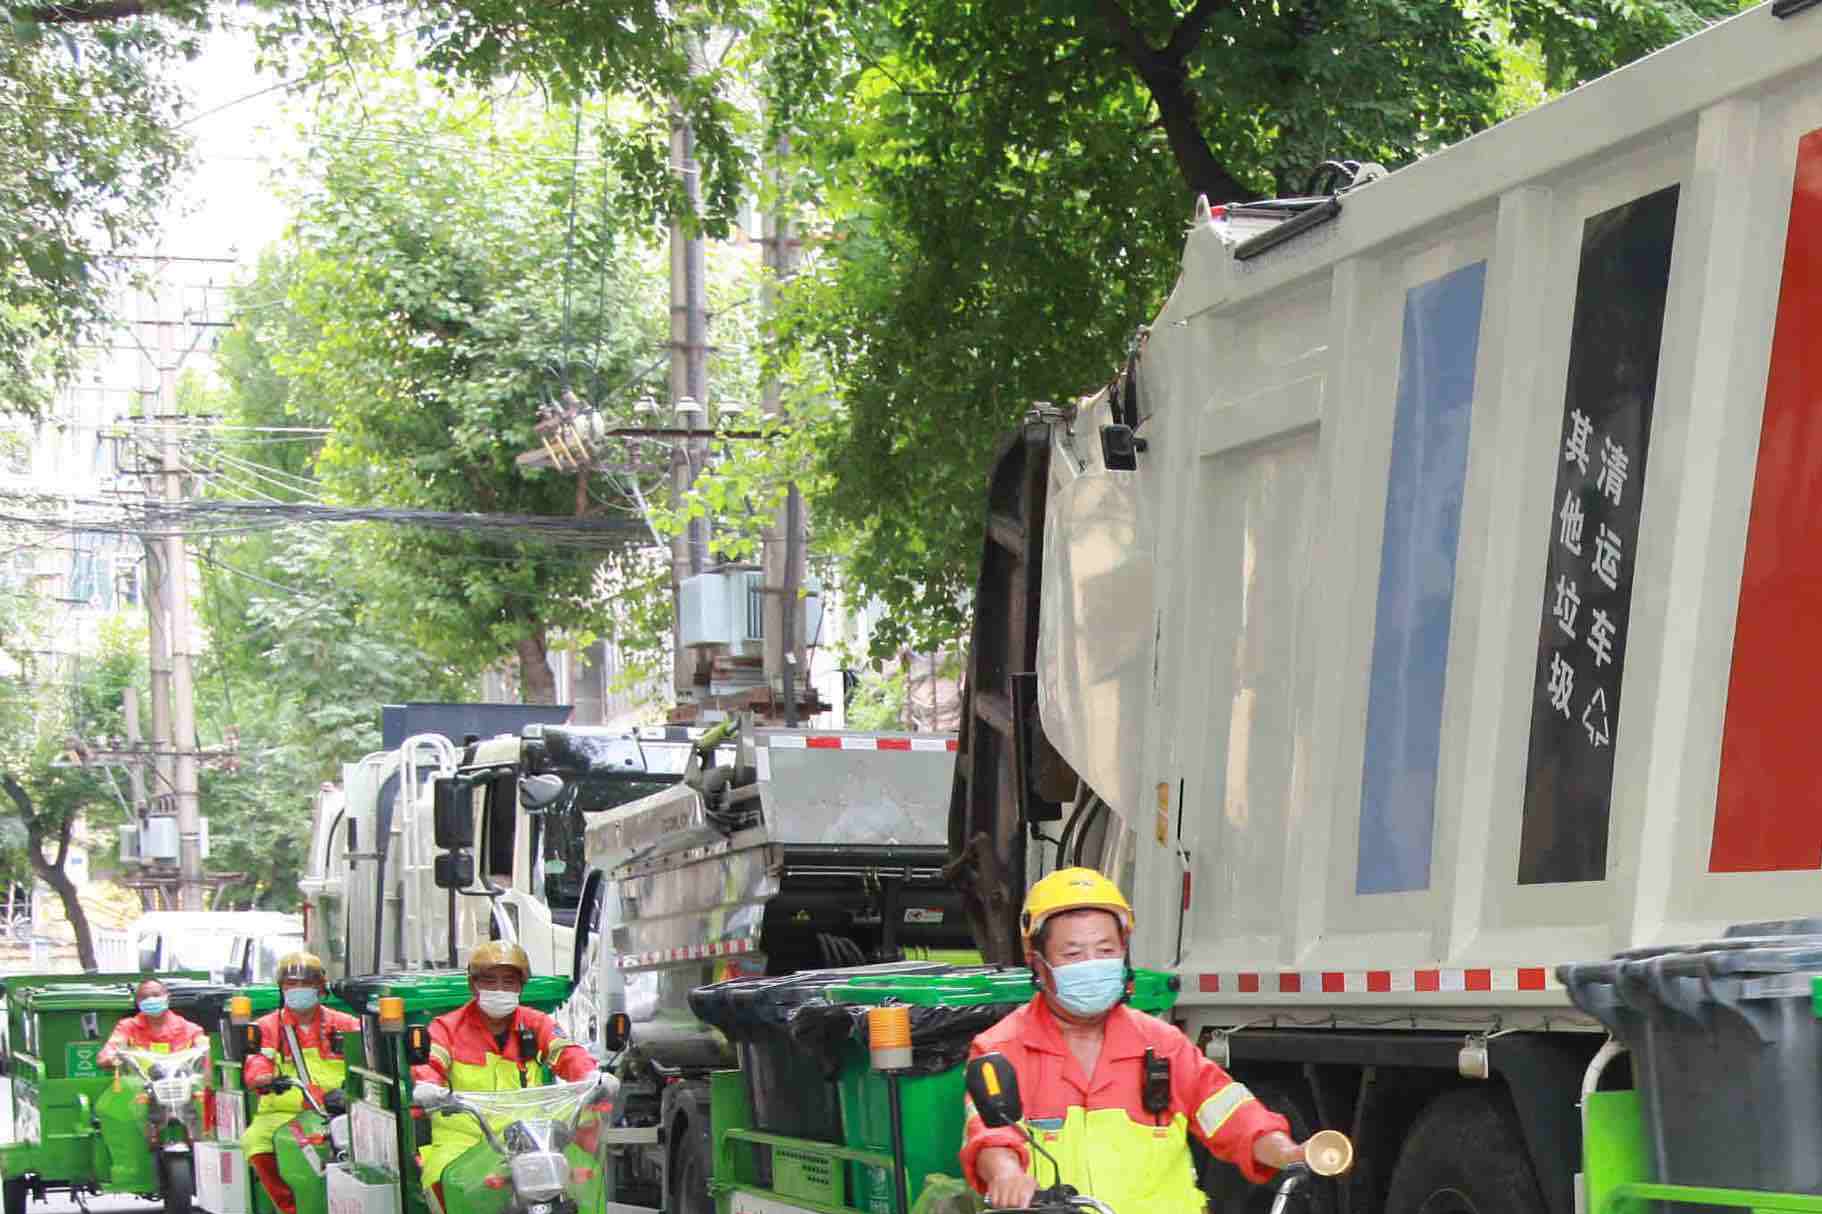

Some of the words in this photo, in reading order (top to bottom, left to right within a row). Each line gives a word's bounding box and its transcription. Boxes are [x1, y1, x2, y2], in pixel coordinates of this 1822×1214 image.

[1548, 408, 1593, 720] 其他垃圾
[1586, 435, 1630, 667] 清运车
